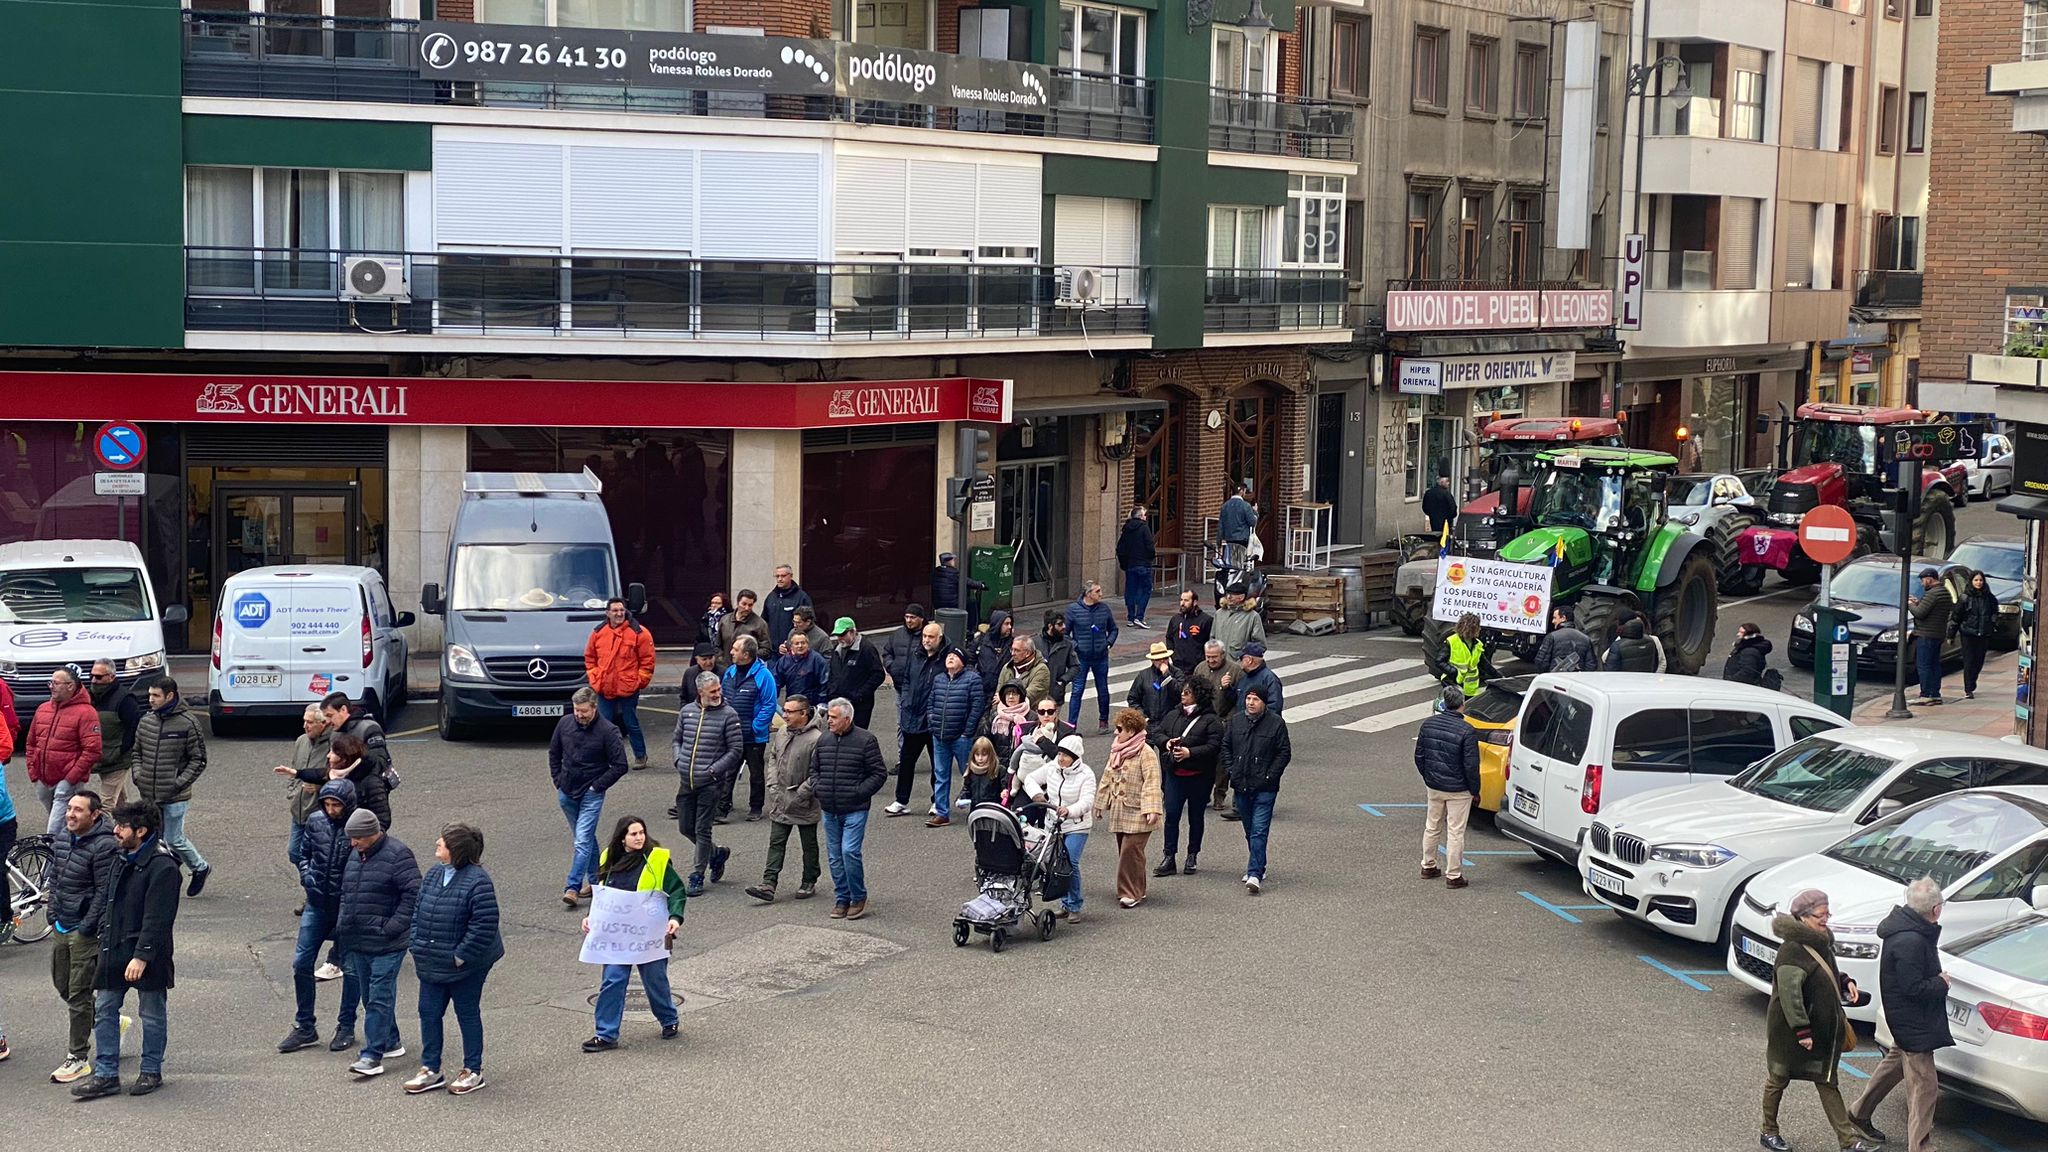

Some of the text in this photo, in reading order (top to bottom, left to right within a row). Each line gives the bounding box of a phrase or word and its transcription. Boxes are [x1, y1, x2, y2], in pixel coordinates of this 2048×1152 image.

[463, 41, 627, 69] 987 26 41 30
[649, 46, 717, 65] podólogo
[649, 63, 773, 78] Vanessa Robles Dorado
[849, 52, 936, 93] podólogo
[951, 85, 1037, 106] Vanessa Robles Dorado
[1394, 293, 1608, 327] UNION DEL PUEBLO LEONES
[1409, 366, 1431, 375] HIPER
[1445, 360, 1538, 383] HIPER ORIENTAL
[1402, 378, 1437, 387] ORIENTAL
[247, 384, 408, 416] GENERALI
[856, 386, 940, 417] GENERALI
[972, 405, 999, 414] GENERALI
[1349, 411, 1361, 422] 13
[1470, 576, 1475, 584] Y
[1477, 577, 1492, 586] SIN
[1471, 565, 1547, 582] SIN AGRICULTURA
[1444, 587, 1498, 600] LOS PUEBLOS
[240, 603, 266, 617] ADT
[1442, 597, 1489, 610] SE MUEREN
[1448, 609, 1464, 618] LOS
[1499, 615, 1509, 624] SE
[75, 631, 132, 642] Ebayón
[1837, 625, 1848, 641] P
[235, 675, 279, 684] 0028 LXF
[518, 706, 561, 715] 4806 LKY
